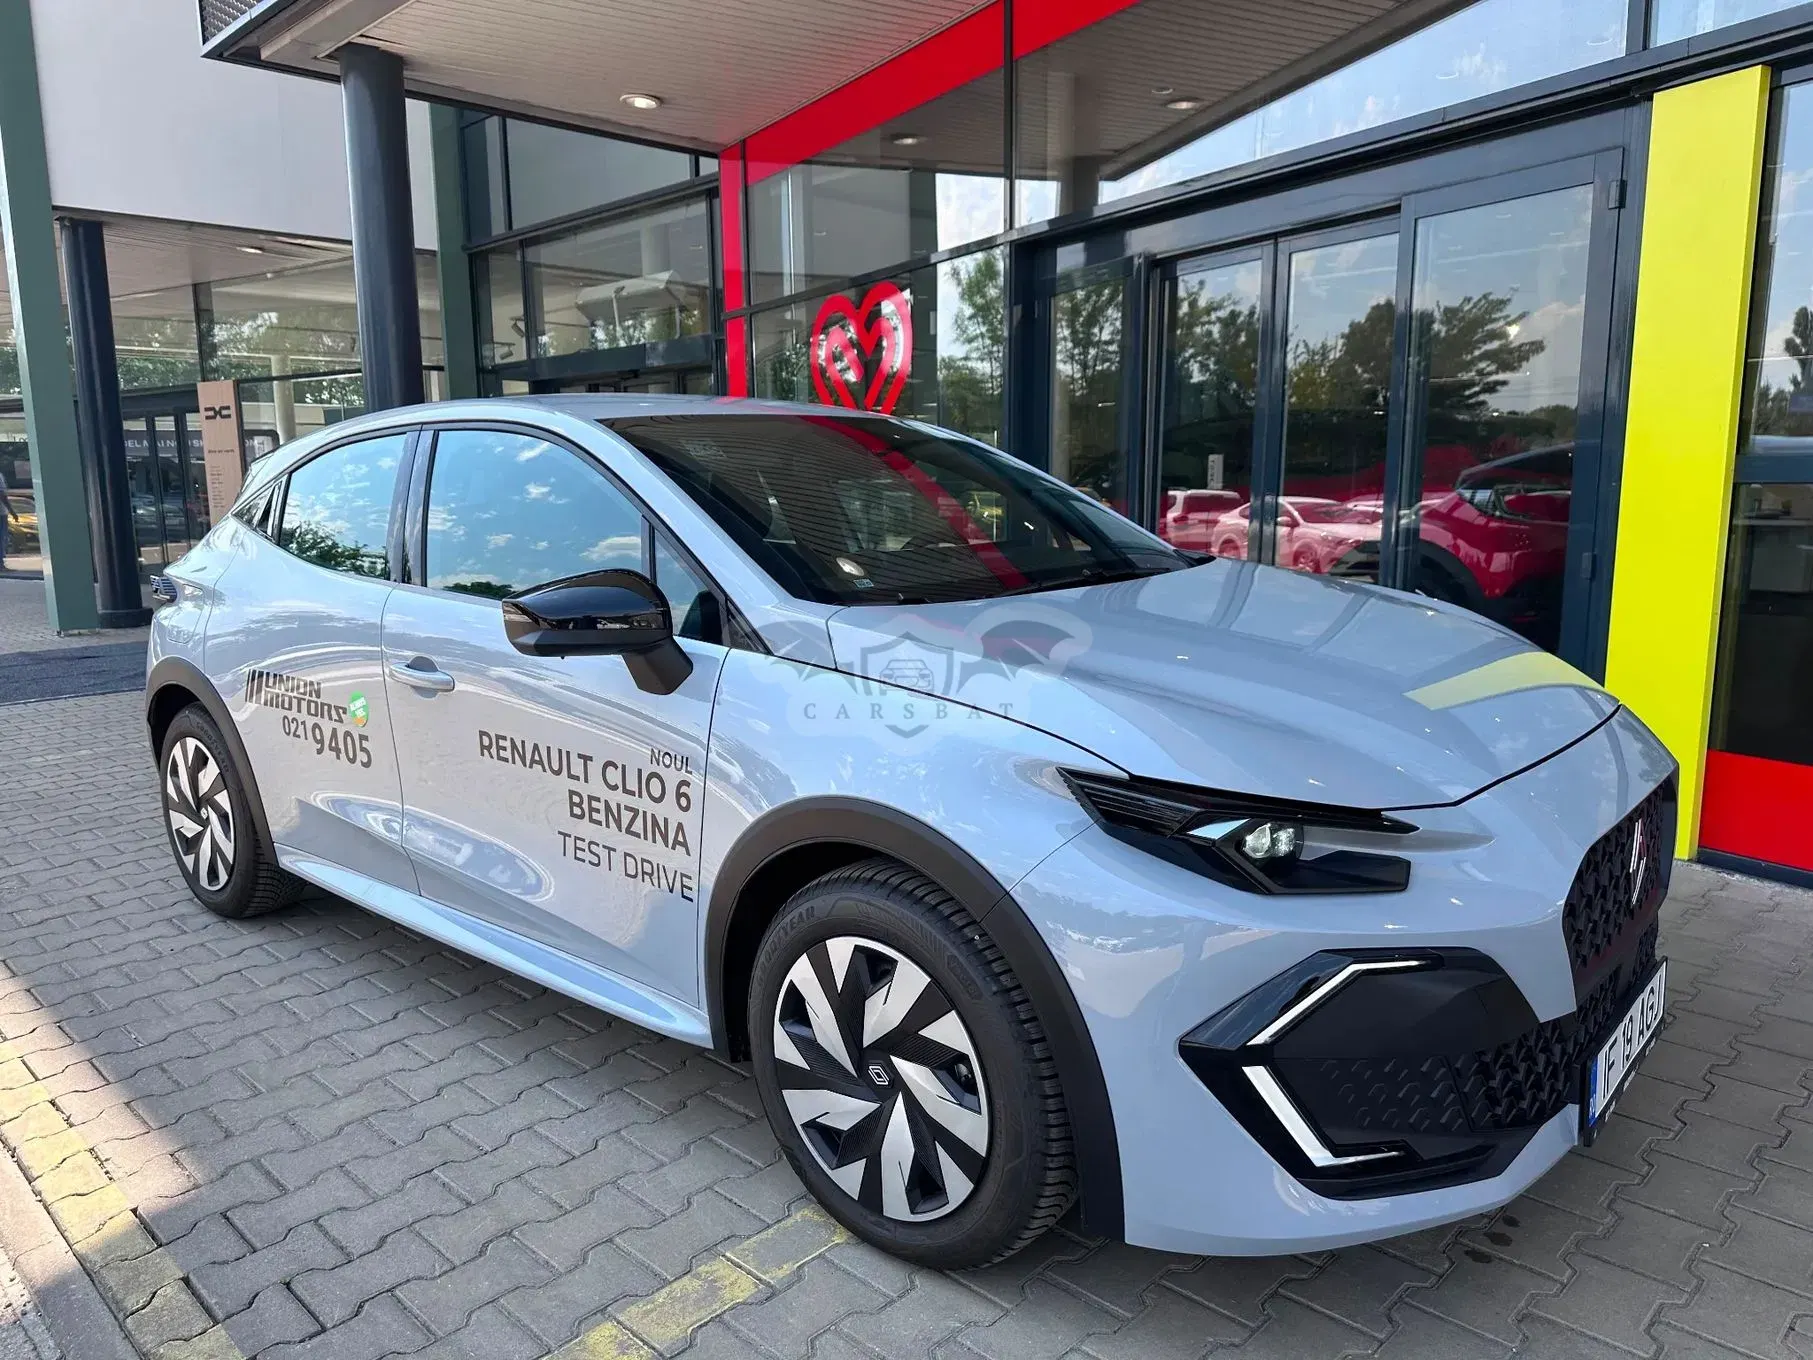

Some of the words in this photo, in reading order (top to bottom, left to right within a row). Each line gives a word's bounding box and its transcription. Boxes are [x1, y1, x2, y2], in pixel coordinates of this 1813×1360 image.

[263, 691, 348, 724] MOTORS
[264, 672, 322, 700] UNION
[282, 715, 309, 741] 021
[311, 722, 373, 769] 9405
[478, 729, 593, 784] RENAULT
[601, 759, 667, 804] CLIO
[674, 779, 692, 813] 6
[650, 747, 693, 775] NOUL
[567, 789, 692, 857] BENZINA
[557, 830, 617, 871] TEST
[623, 851, 694, 902] DRIVE
[1602, 1035, 1618, 1100] IF
[1620, 1014, 1634, 1071] 19
[1635, 973, 1665, 1048] AGJ
